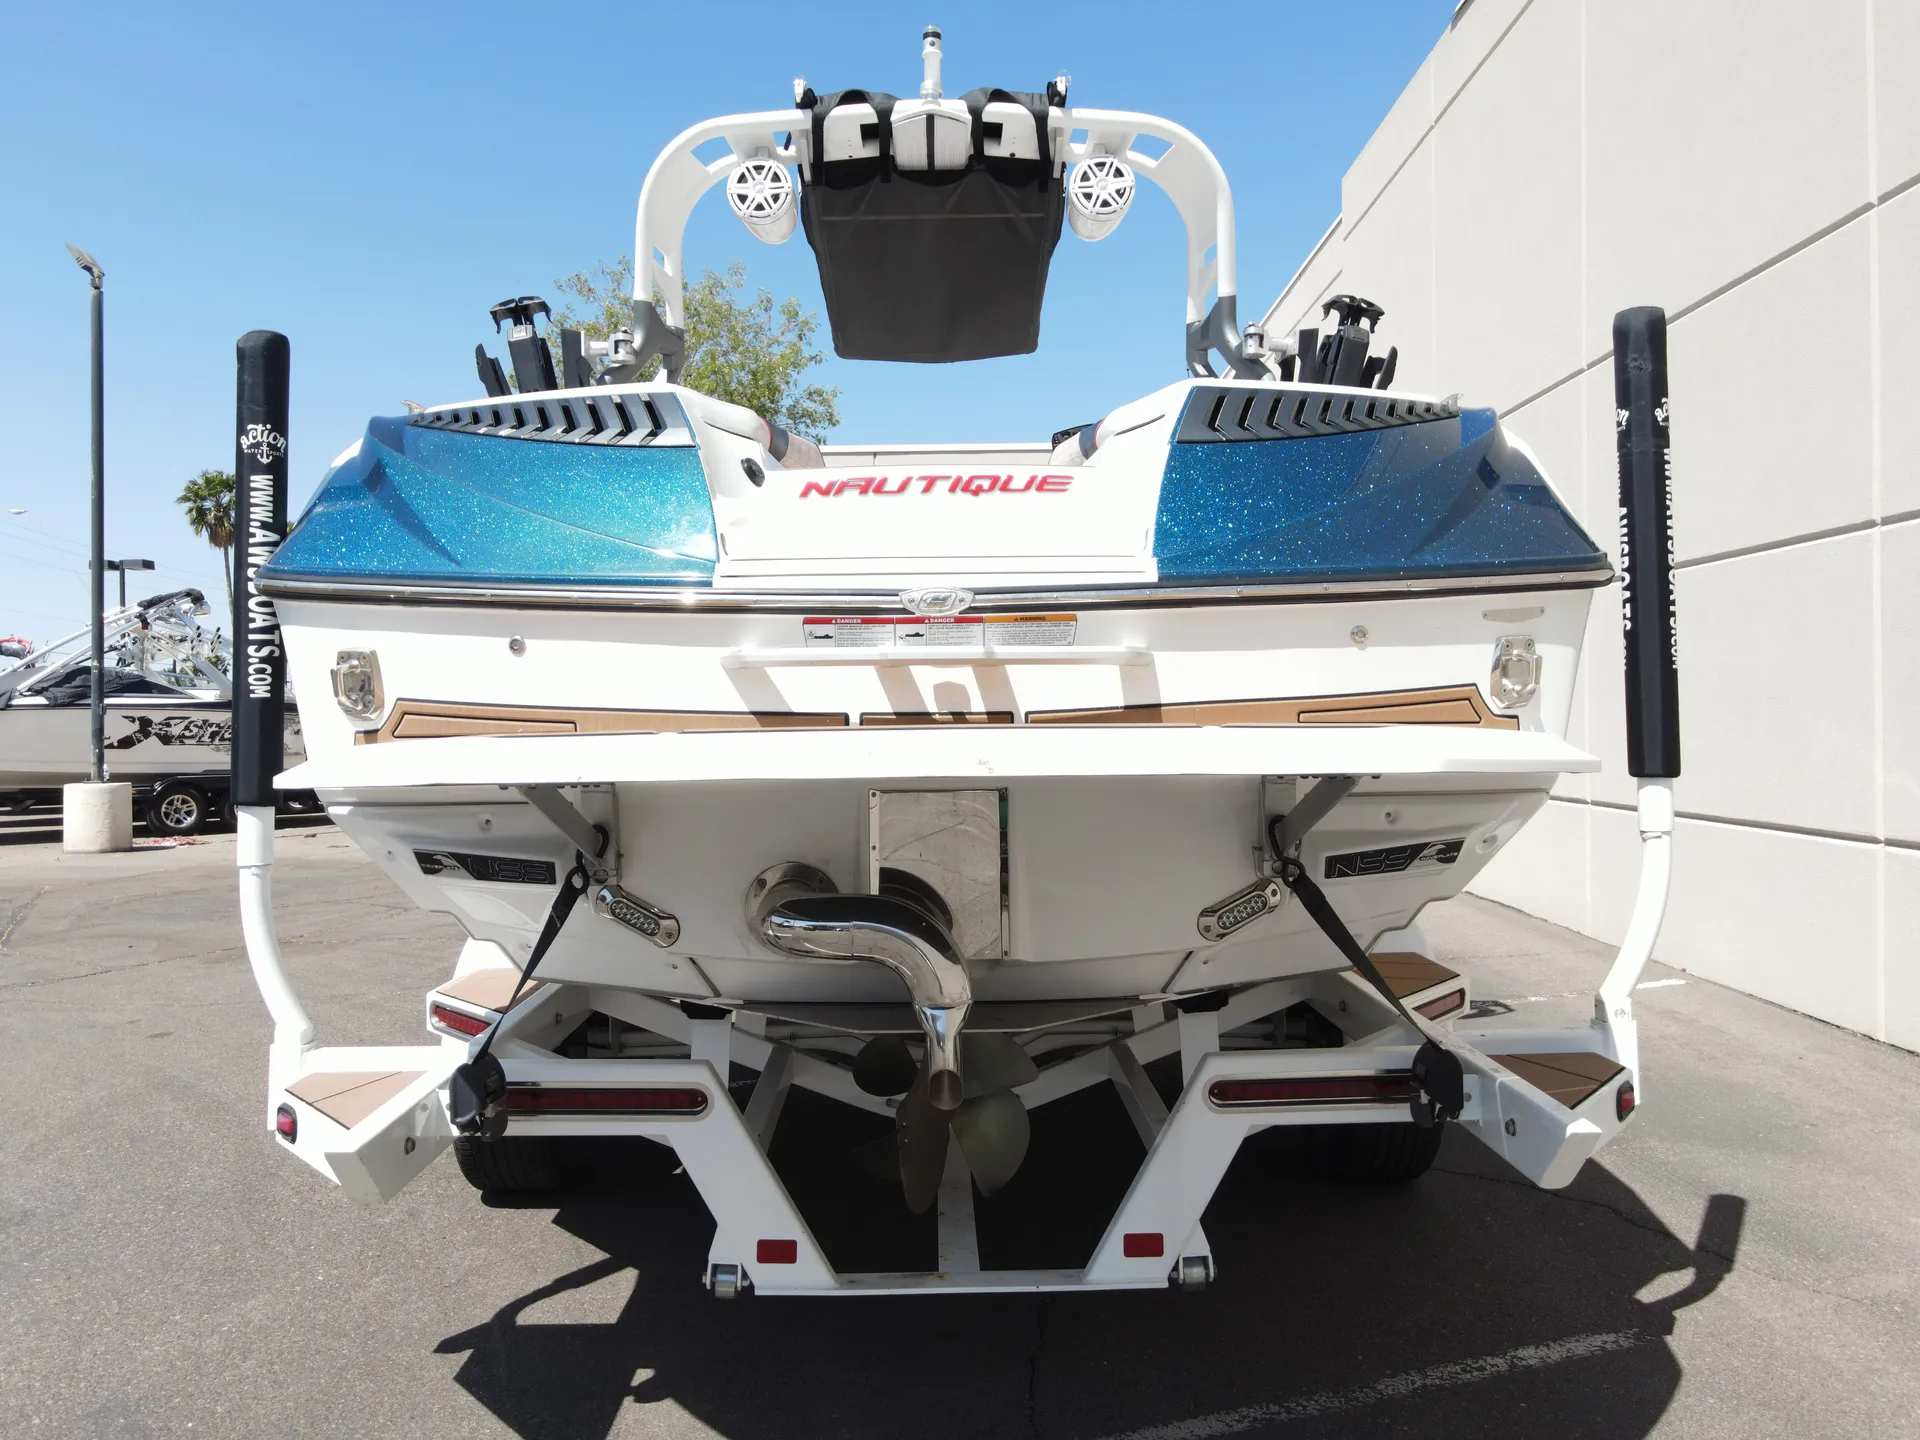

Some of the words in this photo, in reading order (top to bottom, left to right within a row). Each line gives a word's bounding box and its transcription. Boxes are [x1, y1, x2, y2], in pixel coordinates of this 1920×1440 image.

[799, 475, 1075, 497] NAUTIQUE
[247, 474, 281, 698] WWW.AWOATS.COM
[468, 857, 549, 884] NSS
[1328, 849, 1411, 878] NSS
